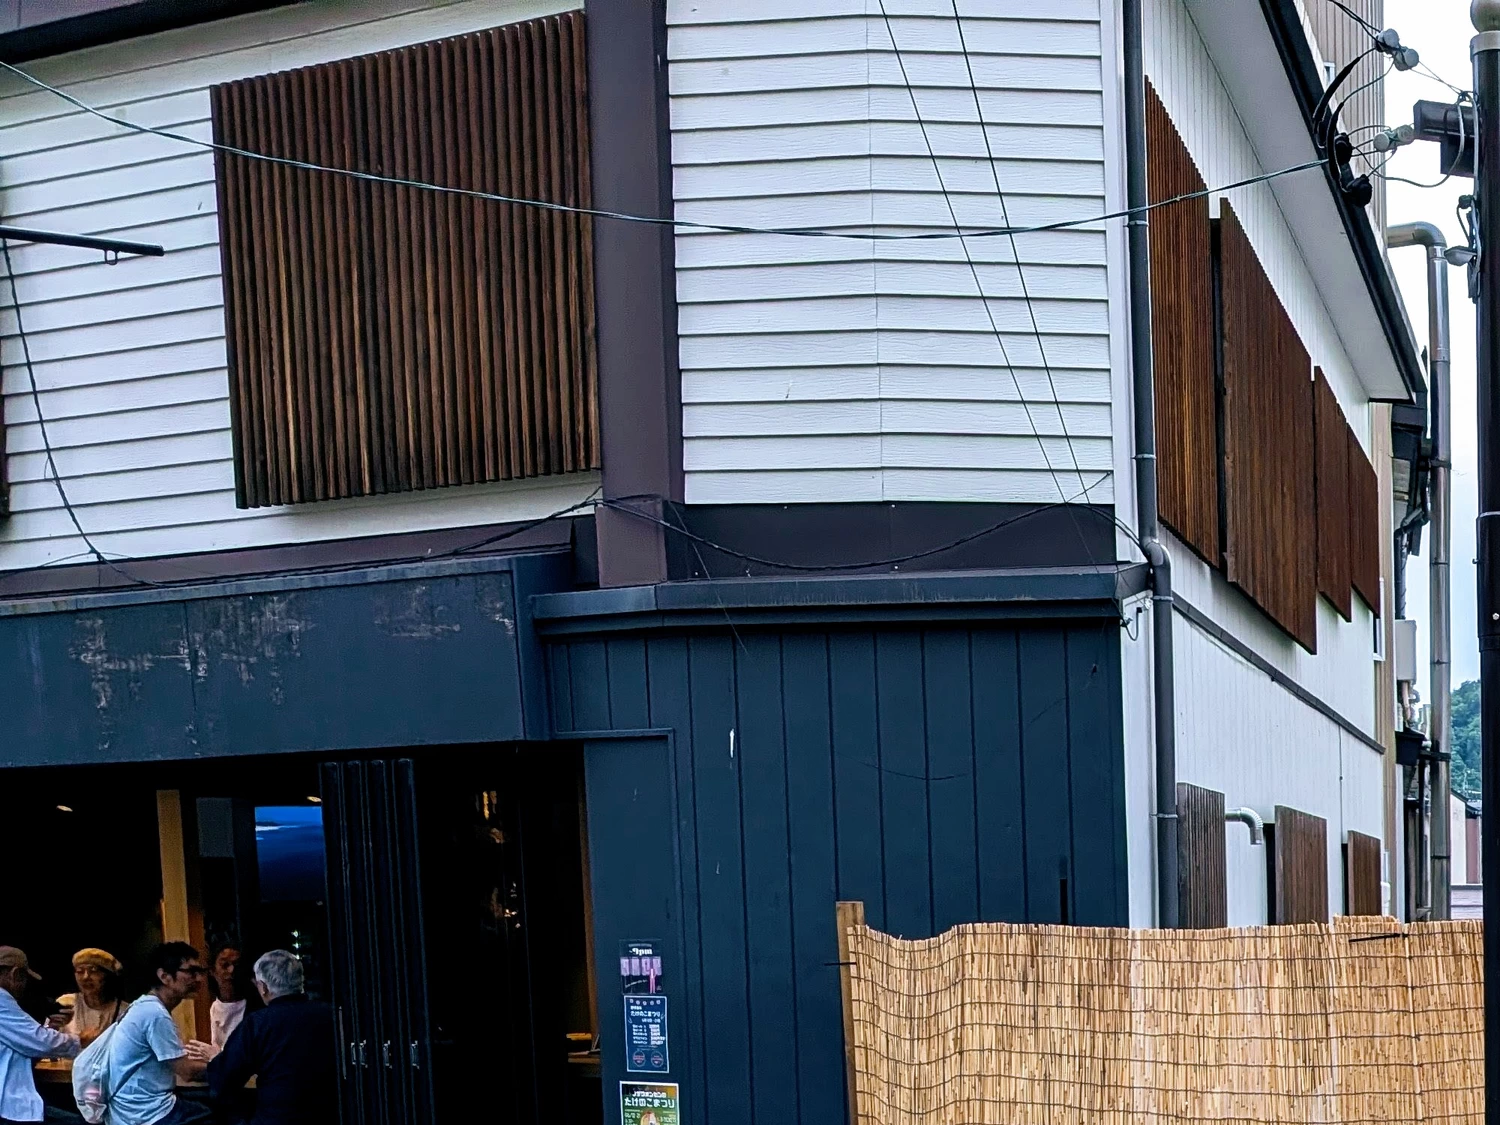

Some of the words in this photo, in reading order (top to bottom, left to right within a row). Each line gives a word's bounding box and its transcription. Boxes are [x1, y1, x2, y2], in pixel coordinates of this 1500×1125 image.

[624, 1097, 675, 1109] たけのこまつり
